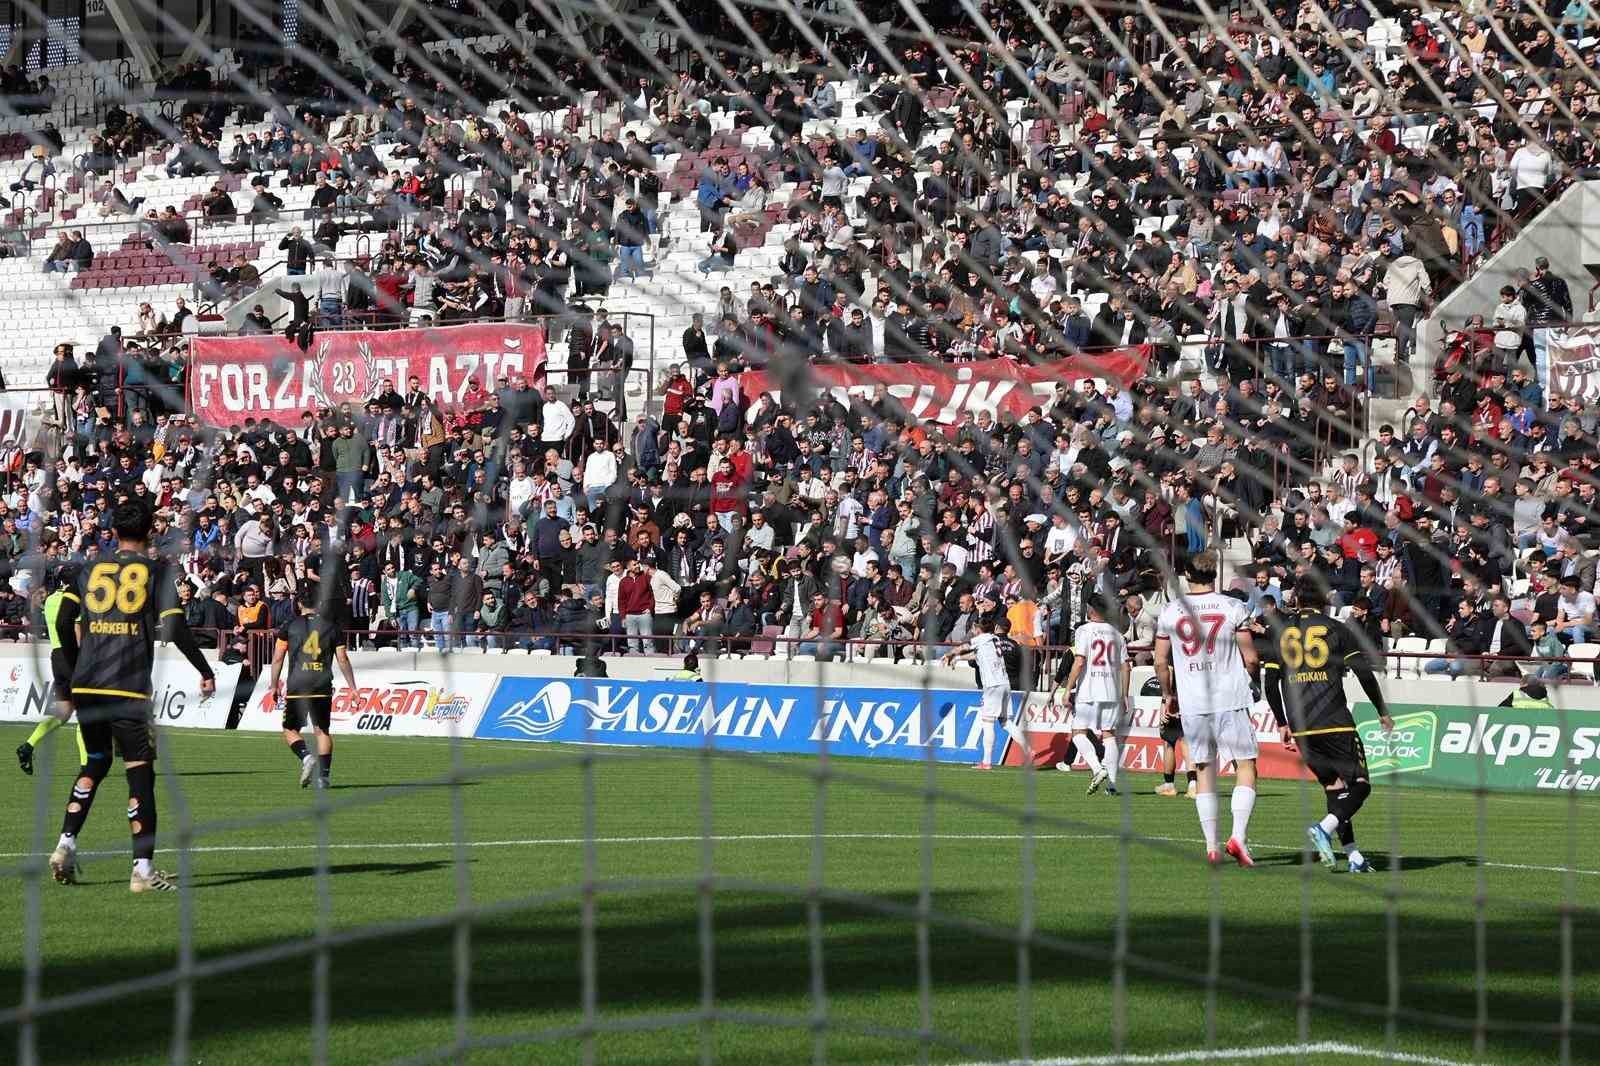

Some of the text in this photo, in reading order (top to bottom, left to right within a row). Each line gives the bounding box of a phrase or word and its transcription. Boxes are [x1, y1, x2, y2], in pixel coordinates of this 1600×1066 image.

[332, 361, 355, 394] 23
[85, 562, 148, 613] 58
[89, 619, 129, 635] GÖRKEM
[303, 630, 321, 660] 4
[1176, 614, 1226, 656] 97
[1280, 625, 1329, 669] 65
[357, 714, 392, 730] GIDA
[1440, 714, 1560, 765] akpa
